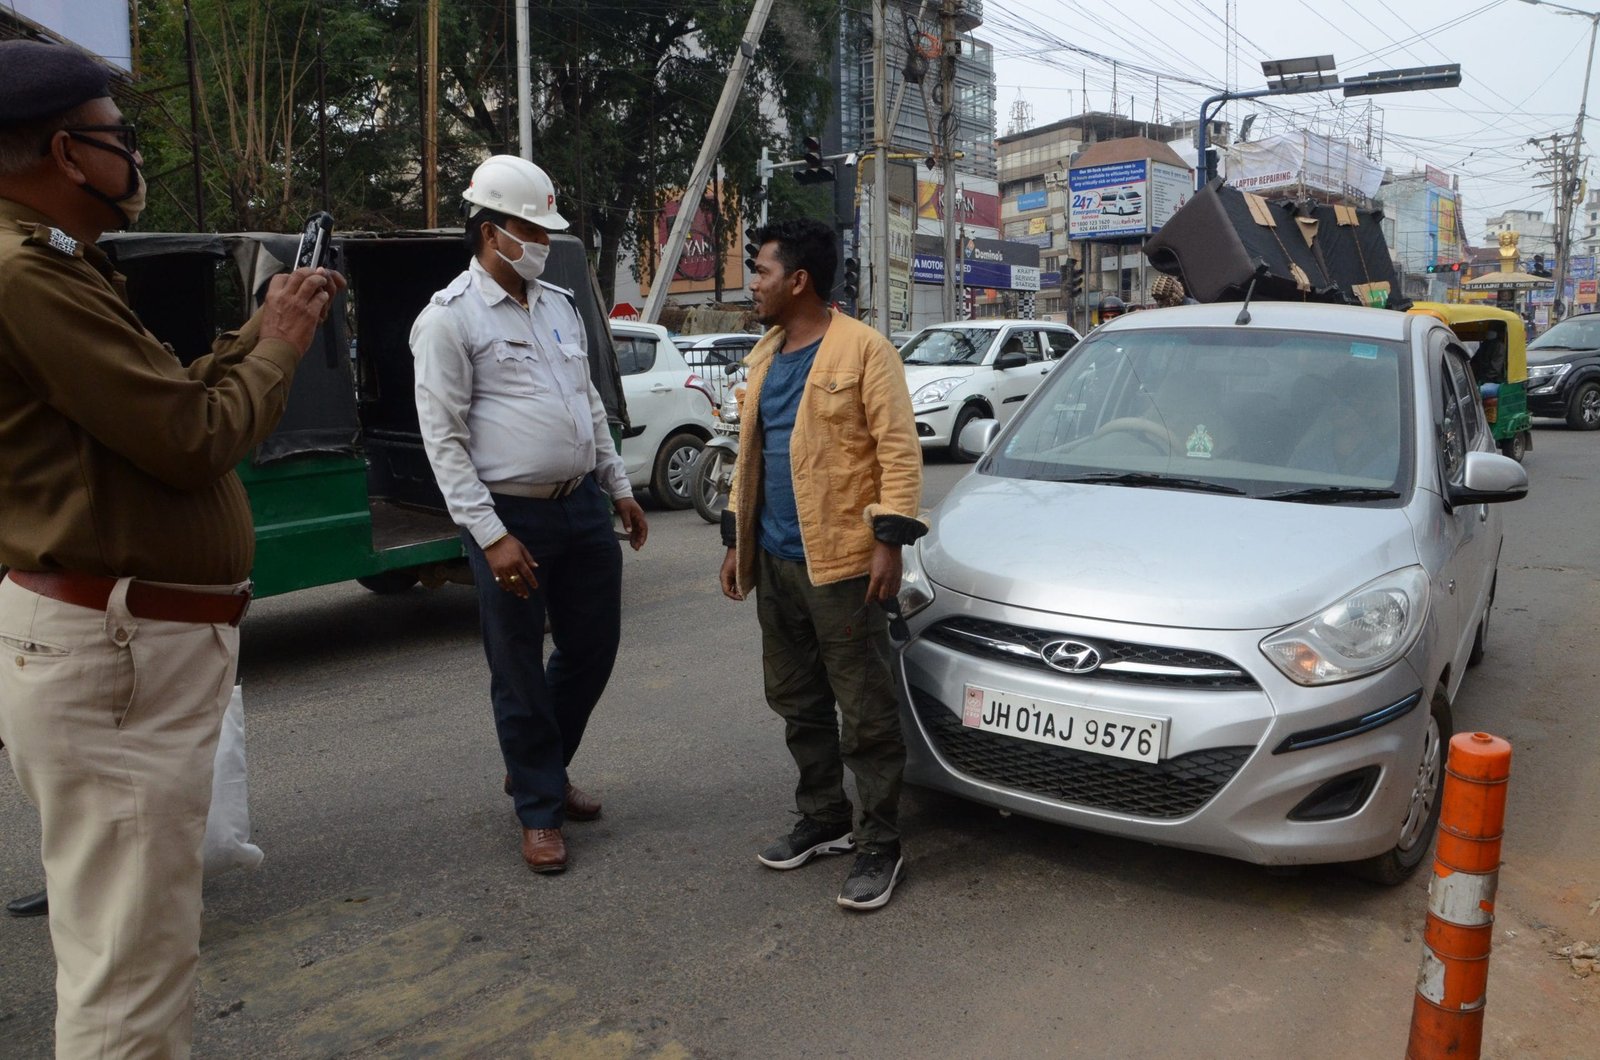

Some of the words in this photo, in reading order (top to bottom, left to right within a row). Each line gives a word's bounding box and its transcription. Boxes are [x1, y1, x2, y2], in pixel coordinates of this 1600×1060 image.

[1235, 178, 1258, 188] LAPTOP
[1259, 171, 1291, 184] REPAIRING
[974, 248, 1003, 261] Domino's
[1017, 268, 1035, 276] KRAFT
[1015, 274, 1037, 282] SERVICE
[1015, 280, 1037, 288] STATION
[1084, 719, 1152, 756] 9576
